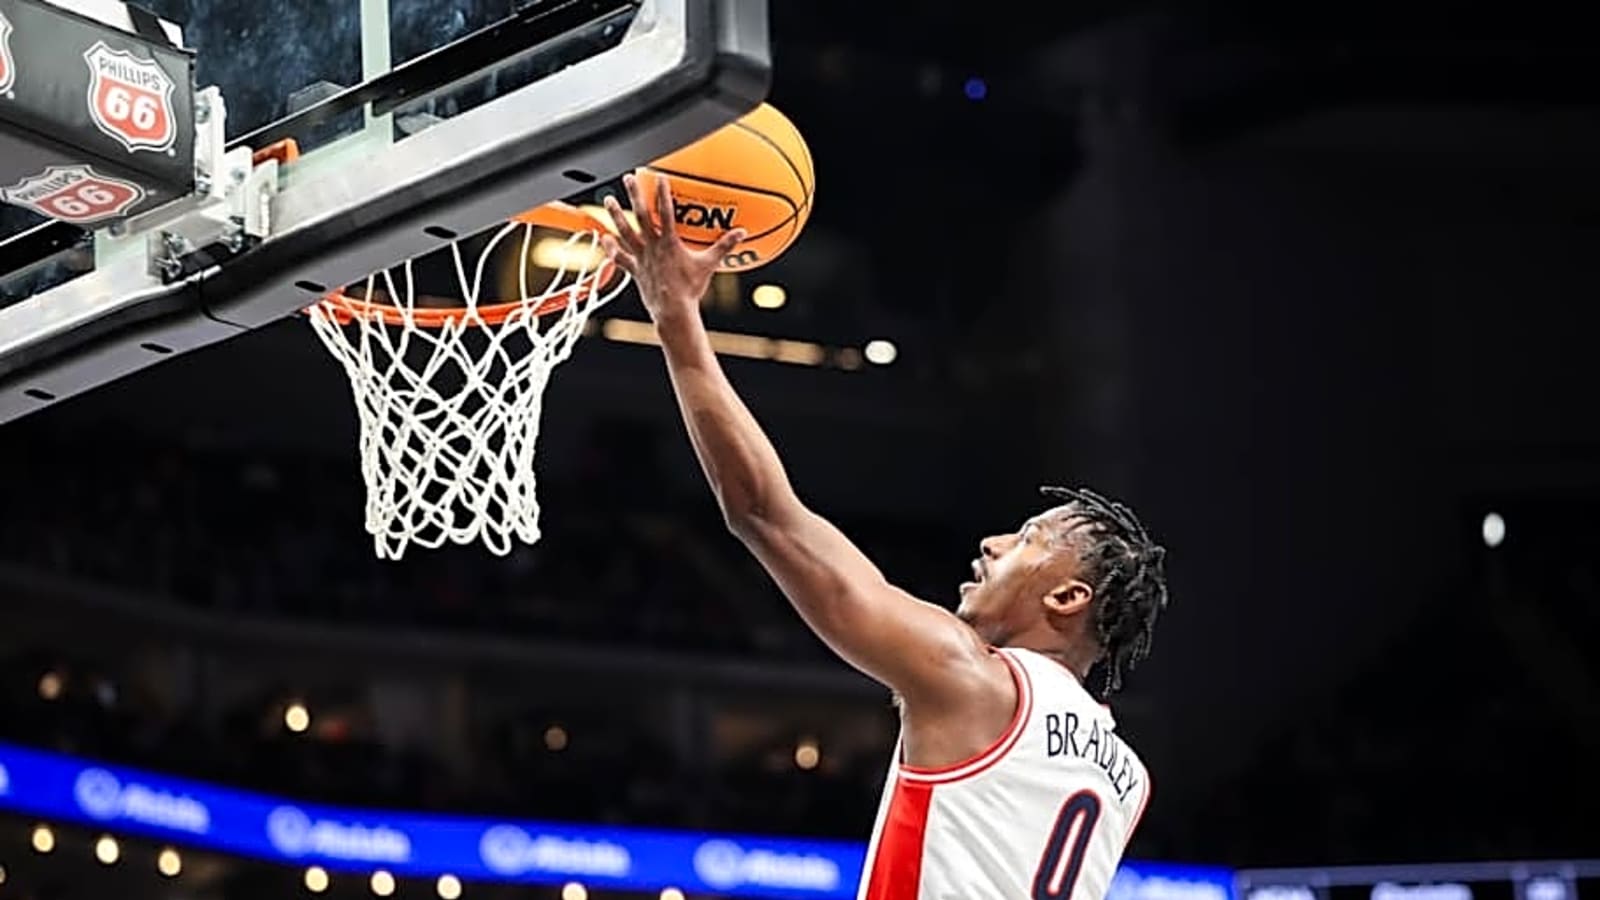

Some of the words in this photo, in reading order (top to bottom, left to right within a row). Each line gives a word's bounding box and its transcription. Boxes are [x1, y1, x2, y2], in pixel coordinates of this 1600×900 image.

[98, 55, 161, 91] PHILLIPS
[105, 86, 157, 131] 66
[52, 184, 115, 215] 66
[671, 197, 736, 231] NCA
[1046, 711, 1138, 804] BRADLEY
[1031, 788, 1102, 900] 0
